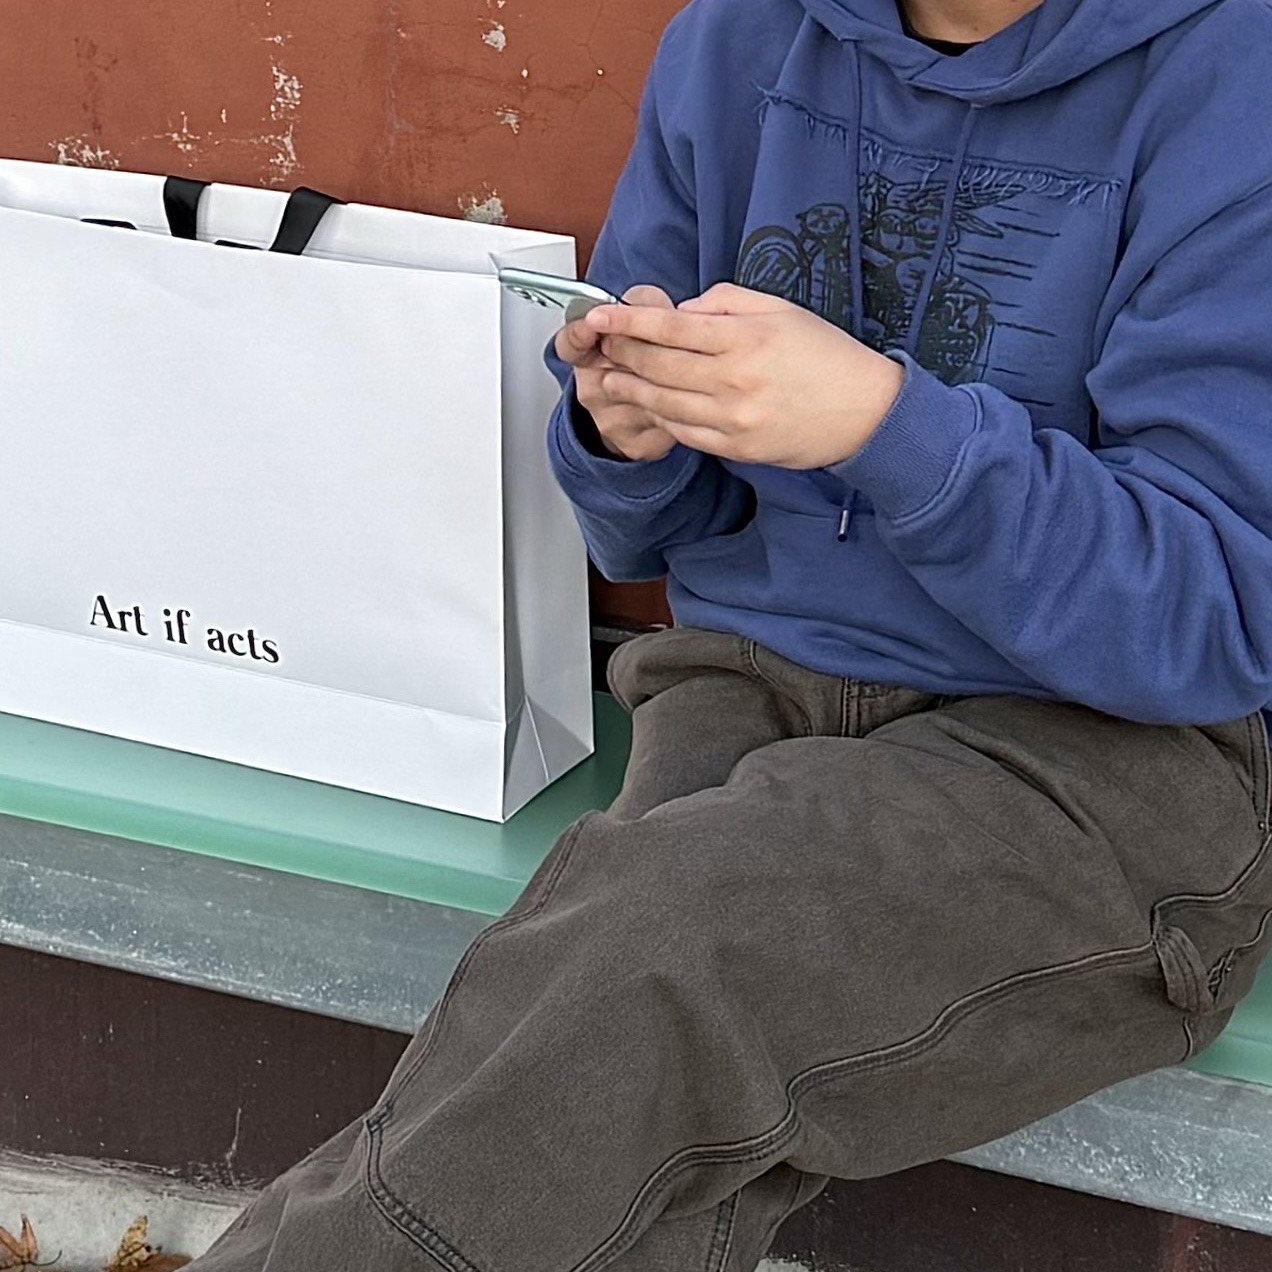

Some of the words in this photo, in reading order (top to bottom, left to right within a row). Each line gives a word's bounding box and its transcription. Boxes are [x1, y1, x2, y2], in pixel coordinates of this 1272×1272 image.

[90, 594, 149, 636] Art
[163, 608, 191, 644] if
[207, 628, 279, 663] acts
